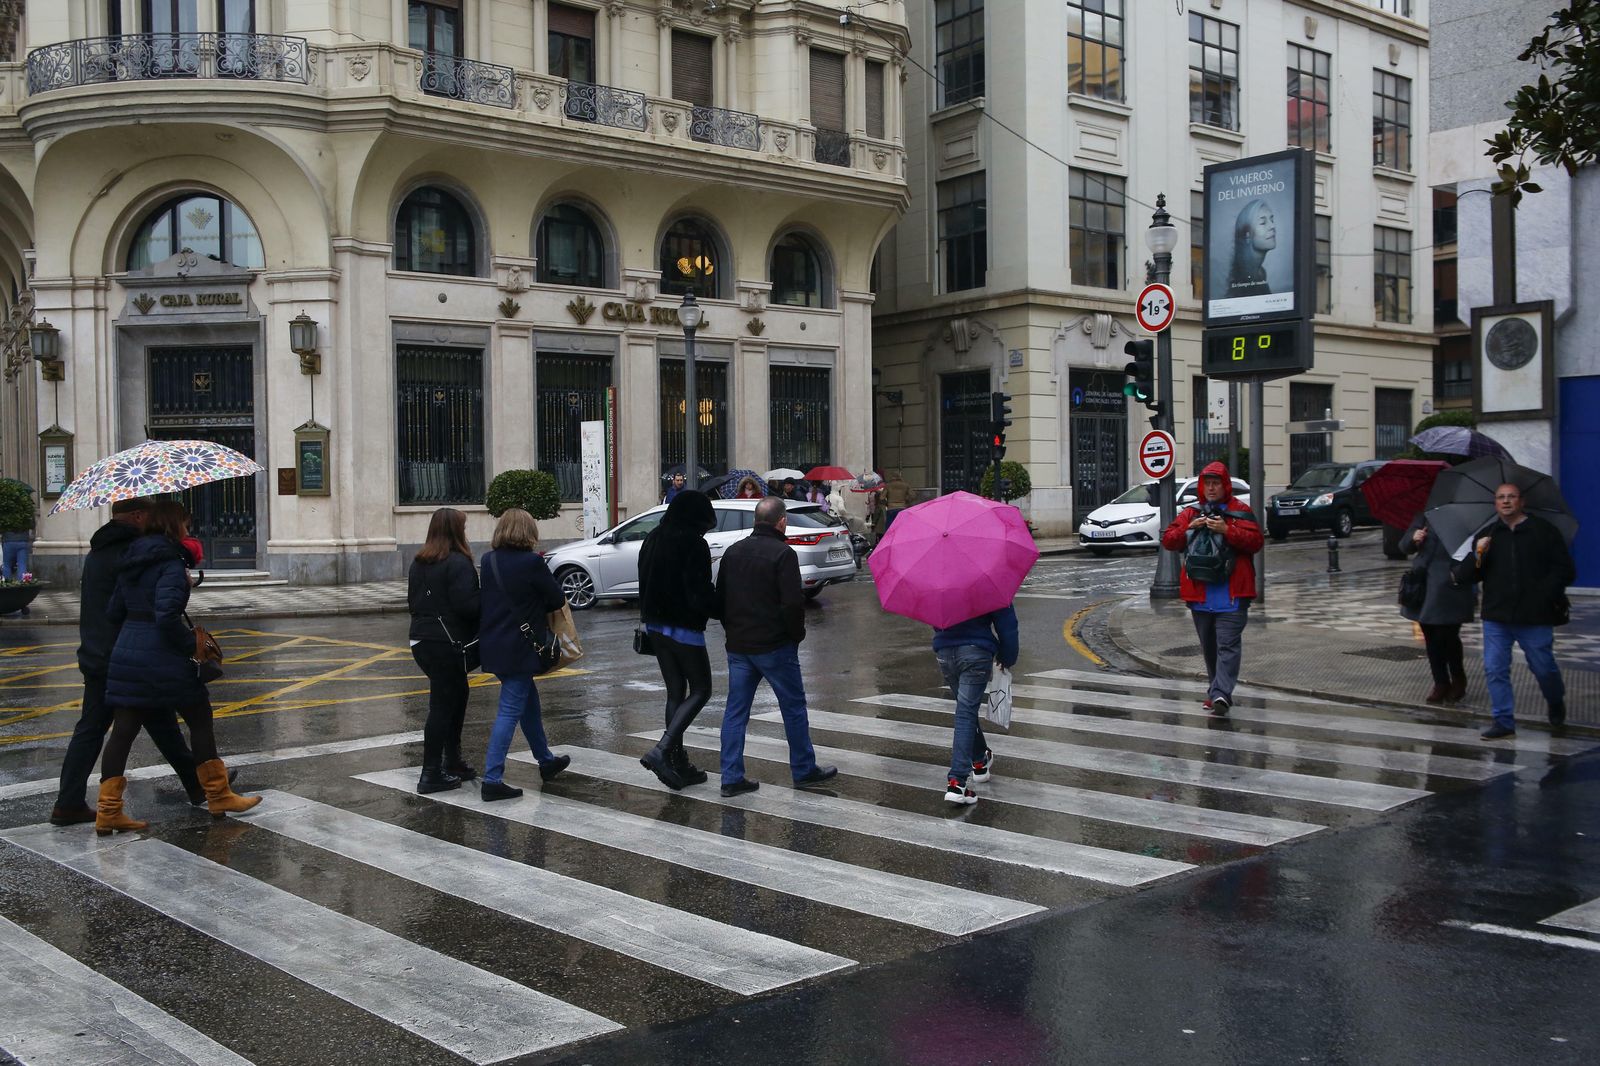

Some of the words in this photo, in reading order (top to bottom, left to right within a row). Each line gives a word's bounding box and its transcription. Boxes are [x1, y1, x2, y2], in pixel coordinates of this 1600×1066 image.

[1229, 169, 1273, 185] VIAJEROS
[1218, 189, 1236, 201] DEL
[1237, 181, 1285, 198] INVIERNO
[160, 294, 193, 307] CAJA
[196, 292, 243, 305] RURAL
[602, 301, 647, 323] CAJA
[649, 306, 710, 329] RUL
